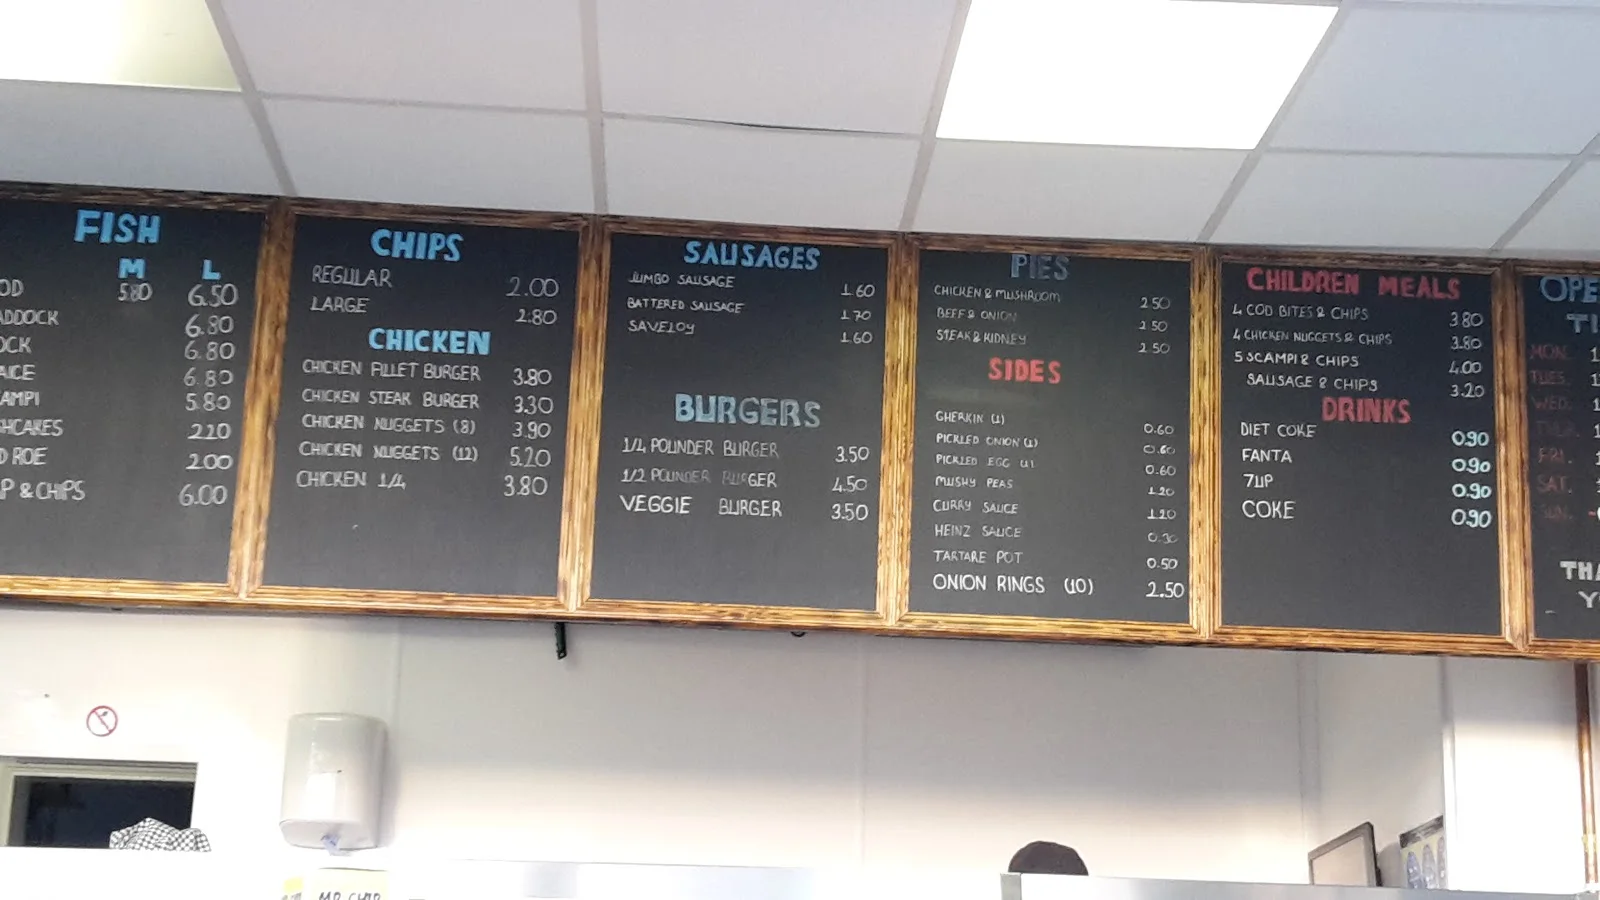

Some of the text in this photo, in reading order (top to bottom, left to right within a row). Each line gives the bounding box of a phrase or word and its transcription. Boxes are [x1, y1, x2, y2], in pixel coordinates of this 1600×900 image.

[75, 210, 160, 243] FISH
[370, 229, 464, 262] CHIPS
[683, 241, 821, 271] SAUSAGES
[118, 258, 221, 280] M L
[1010, 254, 1071, 280] PIES
[311, 265, 559, 298] REGULAR 2.00
[628, 271, 669, 285] JUMBO
[677, 273, 736, 288] SAUSAGE
[1246, 267, 1461, 300] CHILDREN MEALS
[187, 283, 239, 307] 6.50
[627, 297, 685, 310] BATTERED
[690, 301, 745, 314] SAUSAGE
[933, 284, 982, 298] CHICKEN
[984, 288, 992, 299] &
[995, 288, 1061, 303] MUSHROOM
[310, 296, 558, 325] LARGE 2.80
[937, 307, 966, 319] BEEF
[980, 310, 1017, 323] ONION
[1232, 303, 1242, 316] 4
[1246, 304, 1273, 317] COD
[1279, 305, 1313, 318] BITES
[1316, 306, 1326, 318] &
[1331, 307, 1369, 320] CHIPS
[185, 314, 234, 338] 6.80
[628, 320, 695, 335] SAVELOY
[936, 329, 971, 342] STEAK
[983, 333, 1026, 345] KIDNEY
[1232, 329, 1240, 341] 4
[1244, 330, 1289, 341] CHICKEN
[1293, 332, 1342, 343] NUGGETS
[1344, 333, 1354, 343] &
[1358, 333, 1393, 345] CHIPS
[184, 340, 235, 360] 6.80
[368, 327, 491, 355] CHICKEN
[302, 359, 552, 387] CHICKEN FILLET BURGER 3.80
[988, 356, 1061, 385] SIDES
[1234, 351, 1243, 363] 5
[1246, 351, 1297, 365] SCAMPI
[1315, 355, 1359, 367] CHIPS
[1449, 361, 1482, 374] 4.00
[1246, 373, 1485, 398] SAUSAGE & CHIPS 3.20
[302, 388, 554, 415] CHICKEN STEAK BURGER 3.30
[675, 393, 821, 428] BURGERS
[1321, 396, 1411, 424] DRINKS
[302, 413, 552, 440] CHICKEN NUGGETS (8) 3.90
[935, 410, 984, 424] GHERKIN
[1143, 423, 1174, 435] 0.60
[1240, 421, 1270, 437] DIET
[1277, 424, 1317, 438] COKE
[12, 446, 48, 466] ROE
[299, 441, 552, 468] CHICKEN NUGGETS (12) 5.20
[622, 437, 870, 463] 1/4 POUNDER BURGER 3.50
[936, 433, 979, 445] PICKLED
[986, 436, 1019, 447] ONION
[1143, 445, 1175, 455] 0.60
[1241, 448, 1293, 463] FANTA
[936, 454, 978, 466] PICKLED
[987, 457, 1011, 468] EGG
[1145, 464, 1177, 476] 0.60
[296, 470, 548, 497] CHICKEN 1/4 3.80
[620, 468, 868, 493] 1/2 POUNDER BURGER 4.50
[935, 476, 976, 488] MUSHY
[986, 478, 1013, 489] PEAS
[1243, 473, 1274, 488] 7UP
[19, 482, 34, 499] &
[35, 480, 86, 501] CHIPS
[179, 484, 228, 507] 6.00
[619, 494, 869, 521] VEGGIE BURGER 3.50
[933, 499, 971, 513] CURRY
[982, 502, 1018, 514] SAUCE
[1241, 499, 1296, 519] COKE
[934, 524, 971, 537] HEINZ
[981, 525, 1022, 538] SAUCE
[933, 550, 1178, 570] TARTARE POT 0.50
[932, 573, 1185, 598] ONION RINGS (10) 2.50
